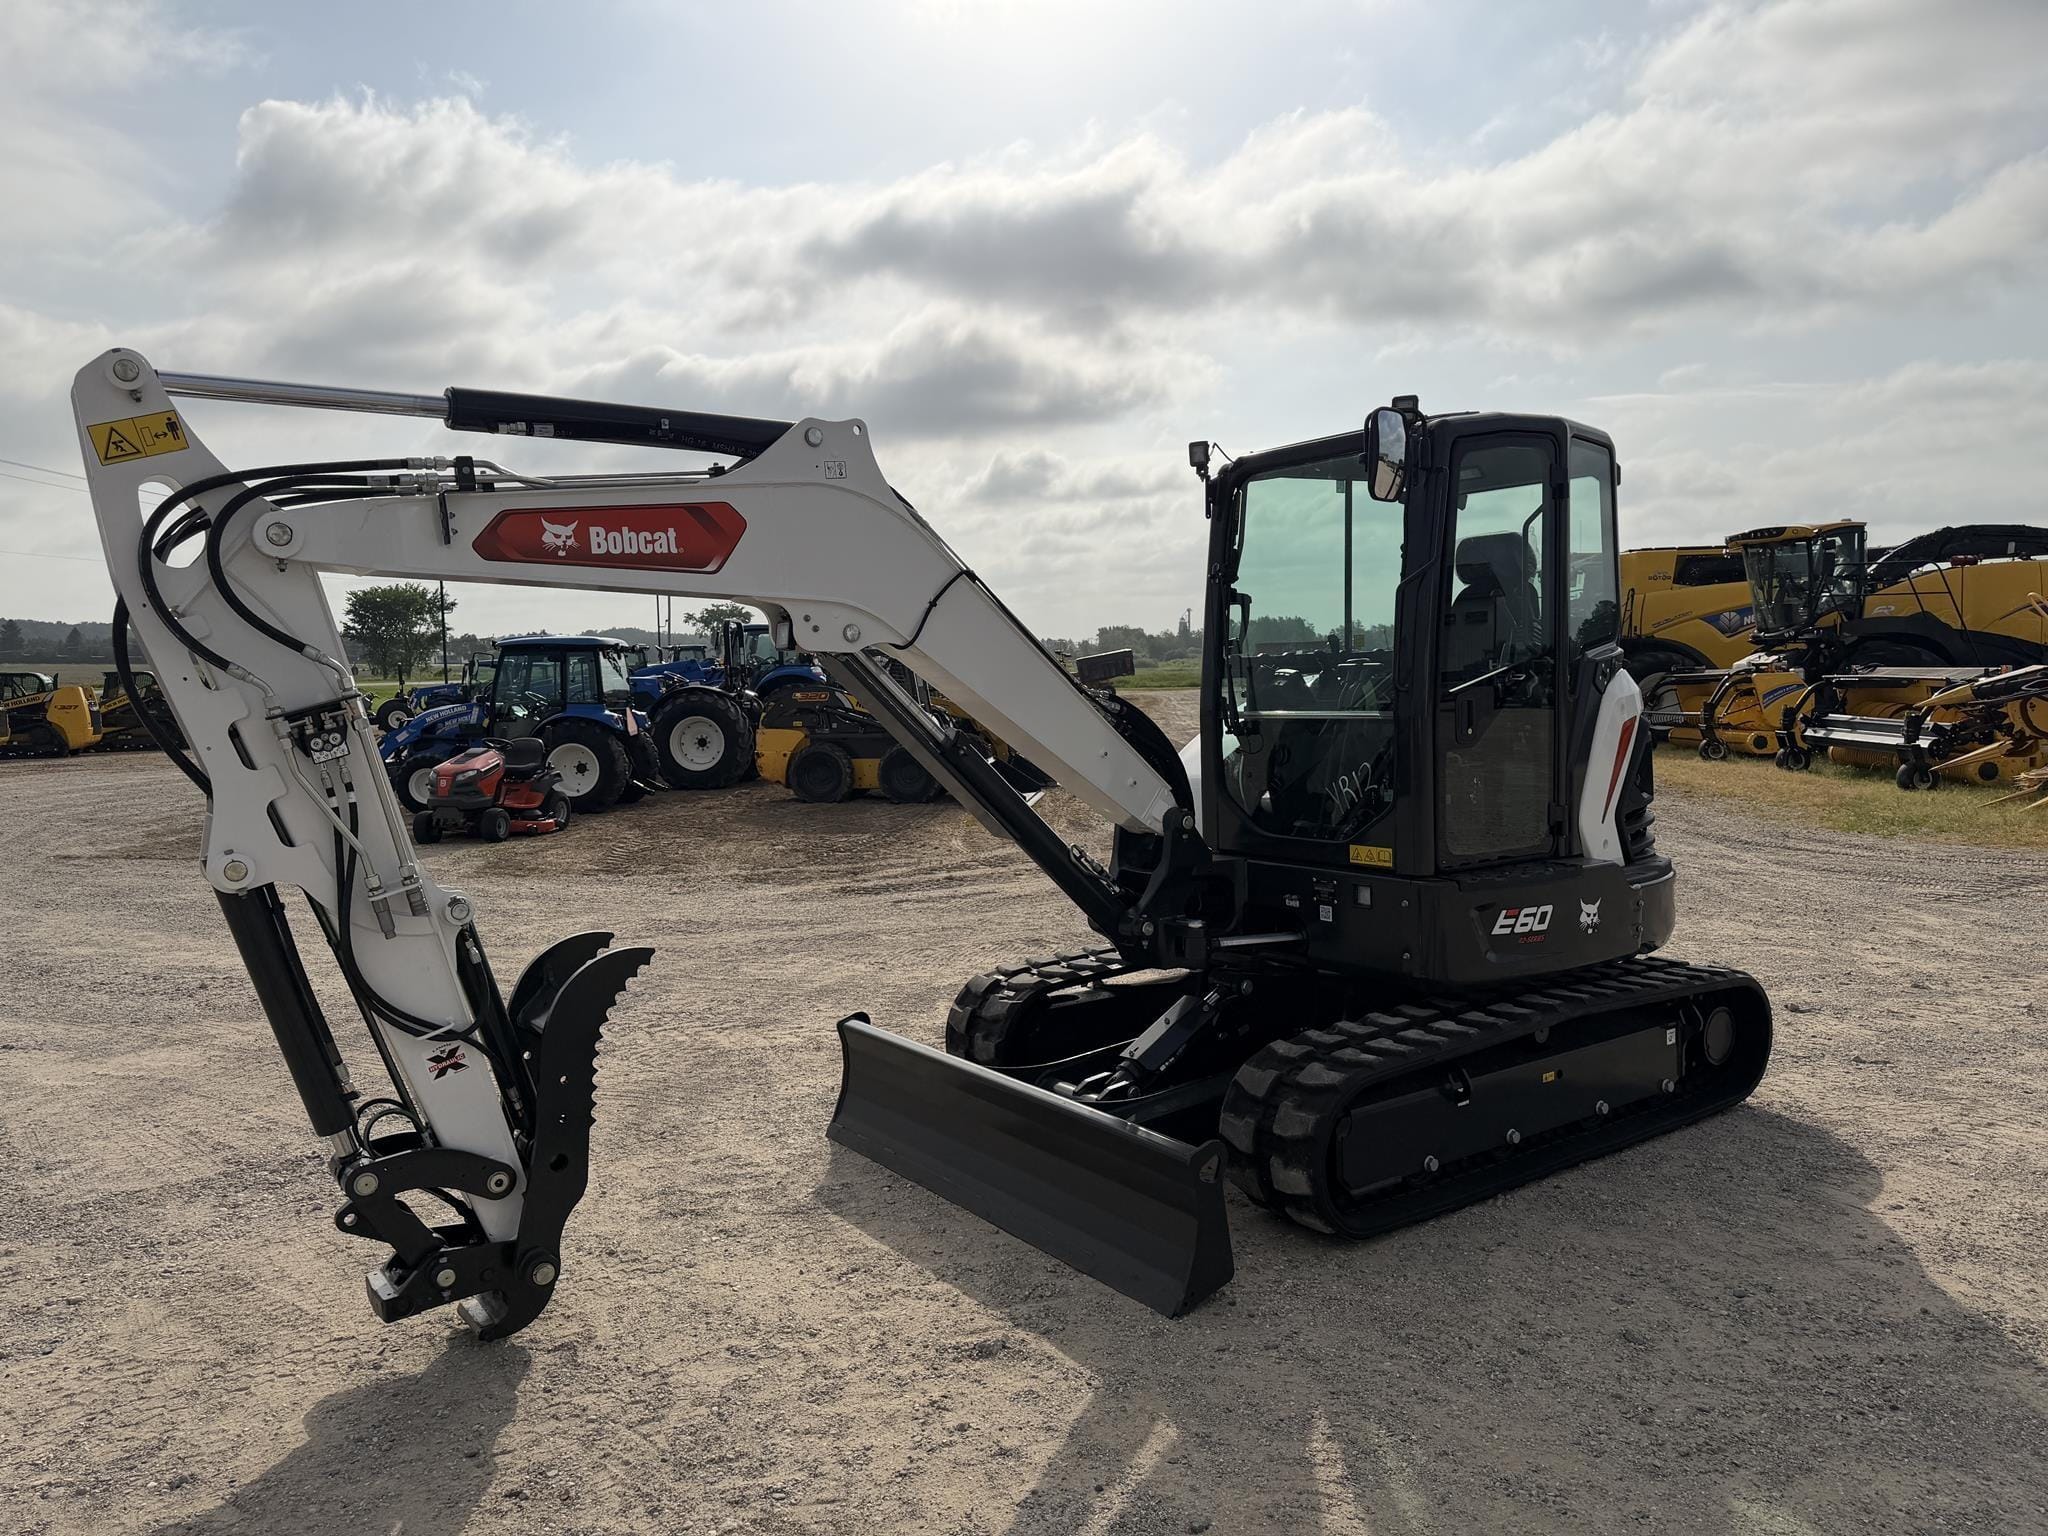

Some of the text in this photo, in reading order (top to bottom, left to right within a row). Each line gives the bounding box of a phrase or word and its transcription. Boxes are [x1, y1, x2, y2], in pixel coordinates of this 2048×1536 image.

[589, 526, 678, 554] Bobcat
[1743, 614, 1756, 626] NE
[11, 696, 40, 707] HOLLAND
[425, 705, 467, 723] NEW HOLLAND
[1491, 904, 1553, 935] E60
